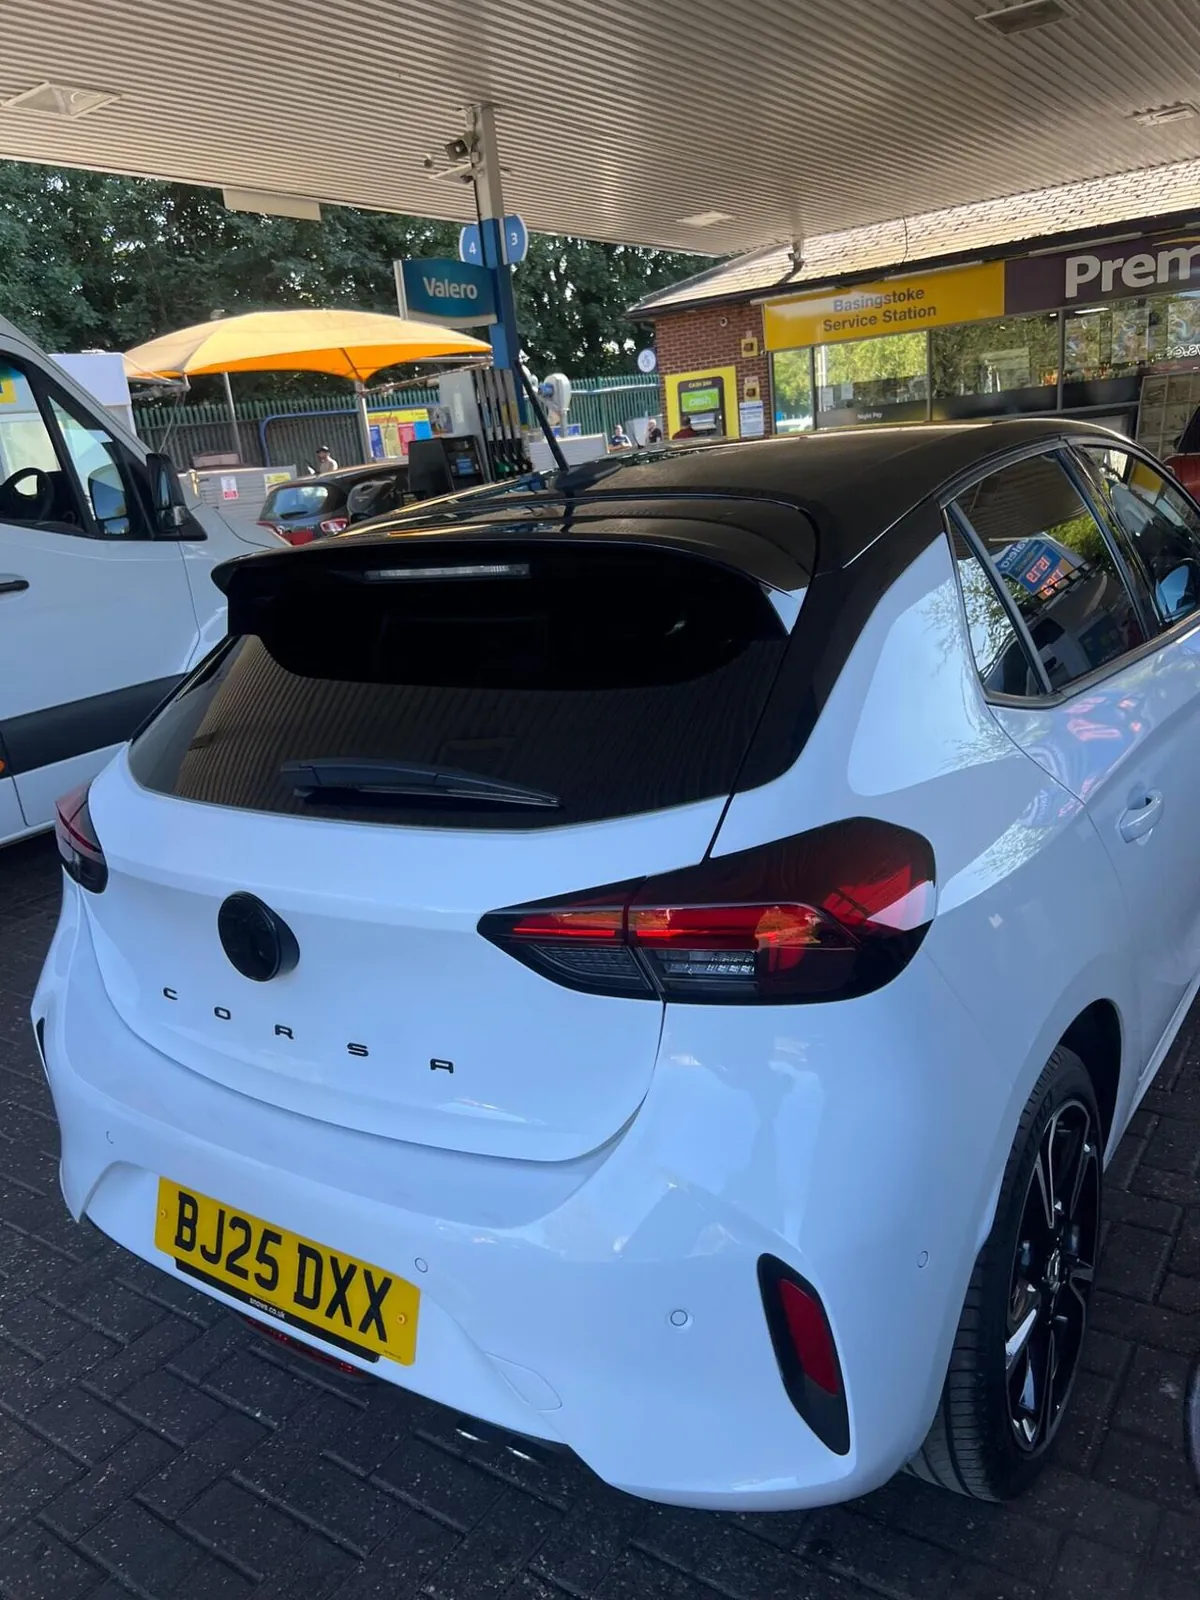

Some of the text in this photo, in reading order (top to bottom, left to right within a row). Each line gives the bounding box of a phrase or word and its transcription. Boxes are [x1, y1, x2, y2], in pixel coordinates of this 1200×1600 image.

[468, 242, 477, 255] 4
[510, 232, 518, 246] 3
[422, 276, 478, 300] Valero
[833, 287, 925, 313] Basingstoke
[823, 305, 937, 333] Service Station
[162, 986, 455, 1075] CORSA
[174, 1190, 392, 1343] BJ25 DXX
